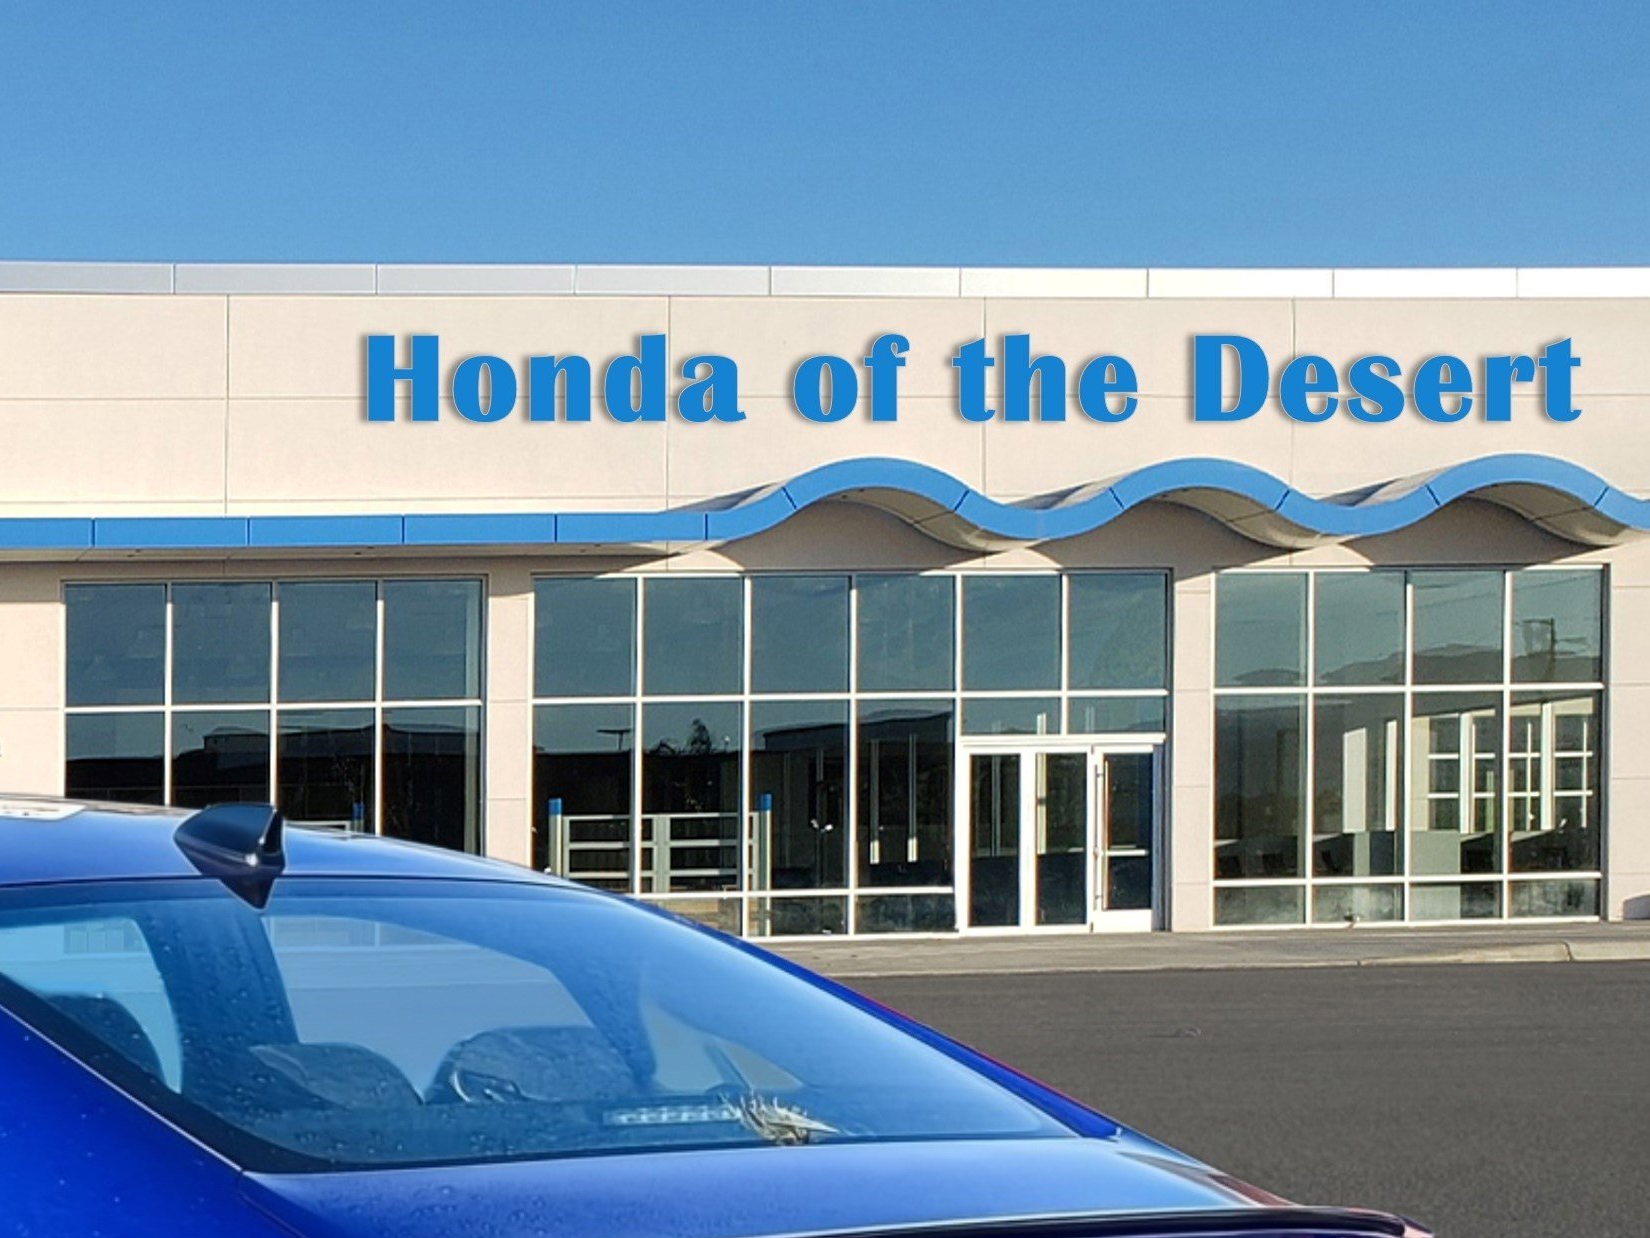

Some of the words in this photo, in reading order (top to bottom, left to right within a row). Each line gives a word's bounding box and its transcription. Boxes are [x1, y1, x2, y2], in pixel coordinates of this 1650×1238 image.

[365, 333, 748, 424] Honda
[792, 332, 911, 424] of
[951, 333, 1139, 424] the
[1193, 334, 1584, 424] Desert
